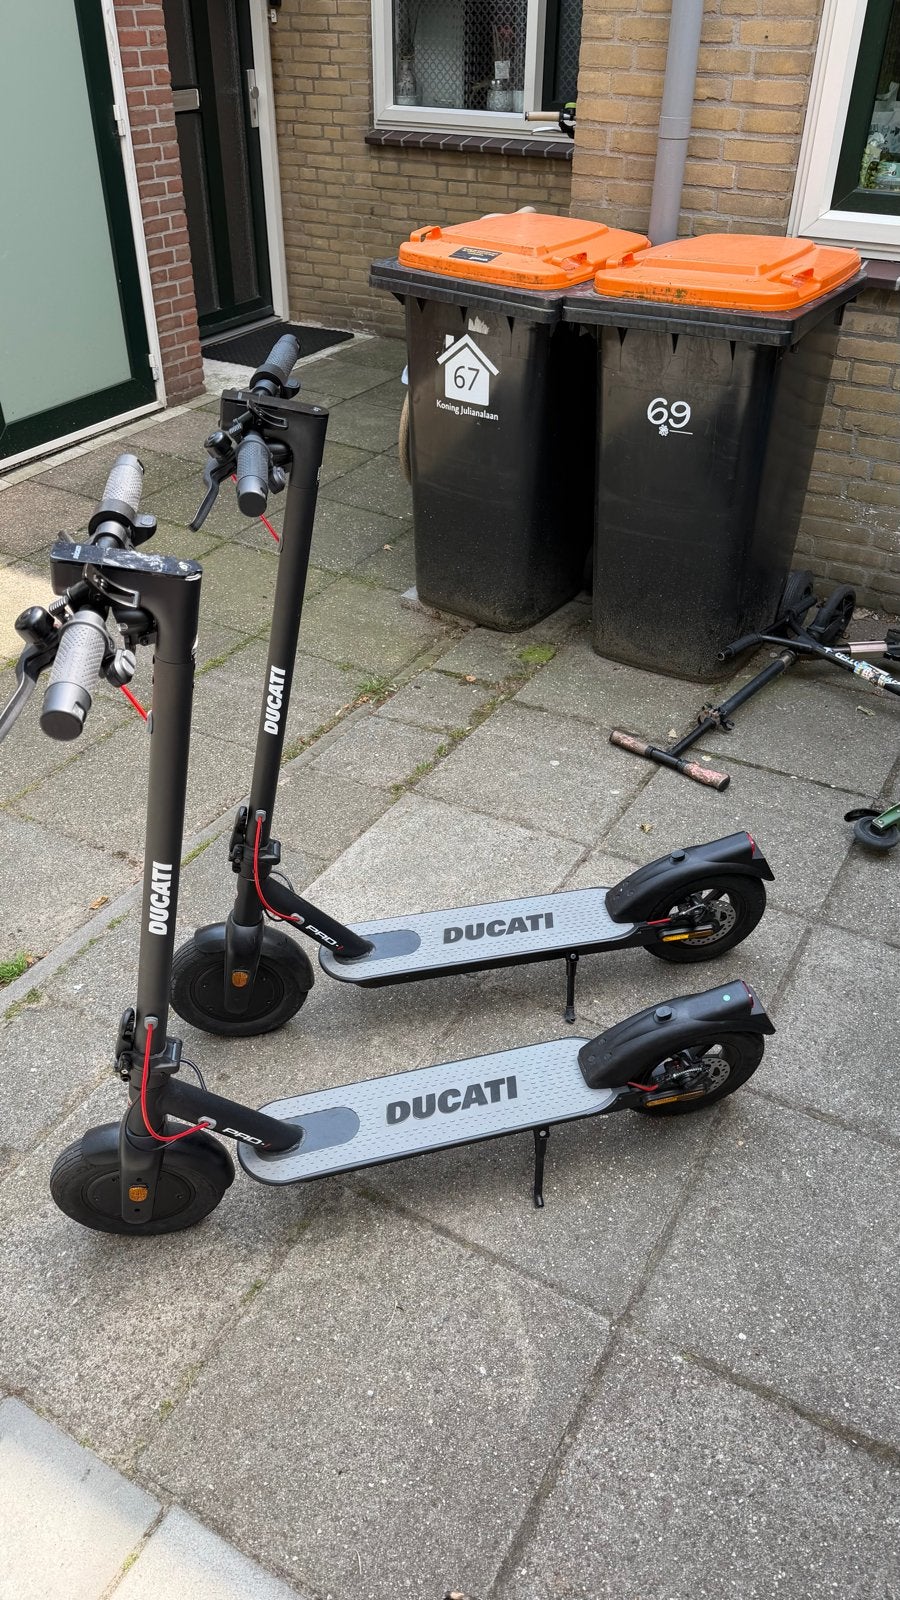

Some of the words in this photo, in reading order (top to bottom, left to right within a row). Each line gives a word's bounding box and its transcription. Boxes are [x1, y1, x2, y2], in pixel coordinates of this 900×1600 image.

[454, 365, 480, 391] 67
[436, 399, 460, 415] Koning
[460, 405, 499, 421] Julianalaan
[647, 397, 691, 429] 69
[263, 664, 286, 735] DUCATI
[148, 860, 173, 936] DUCATI
[443, 912, 554, 944] DUCATI
[386, 1075, 518, 1125] DUCATI
